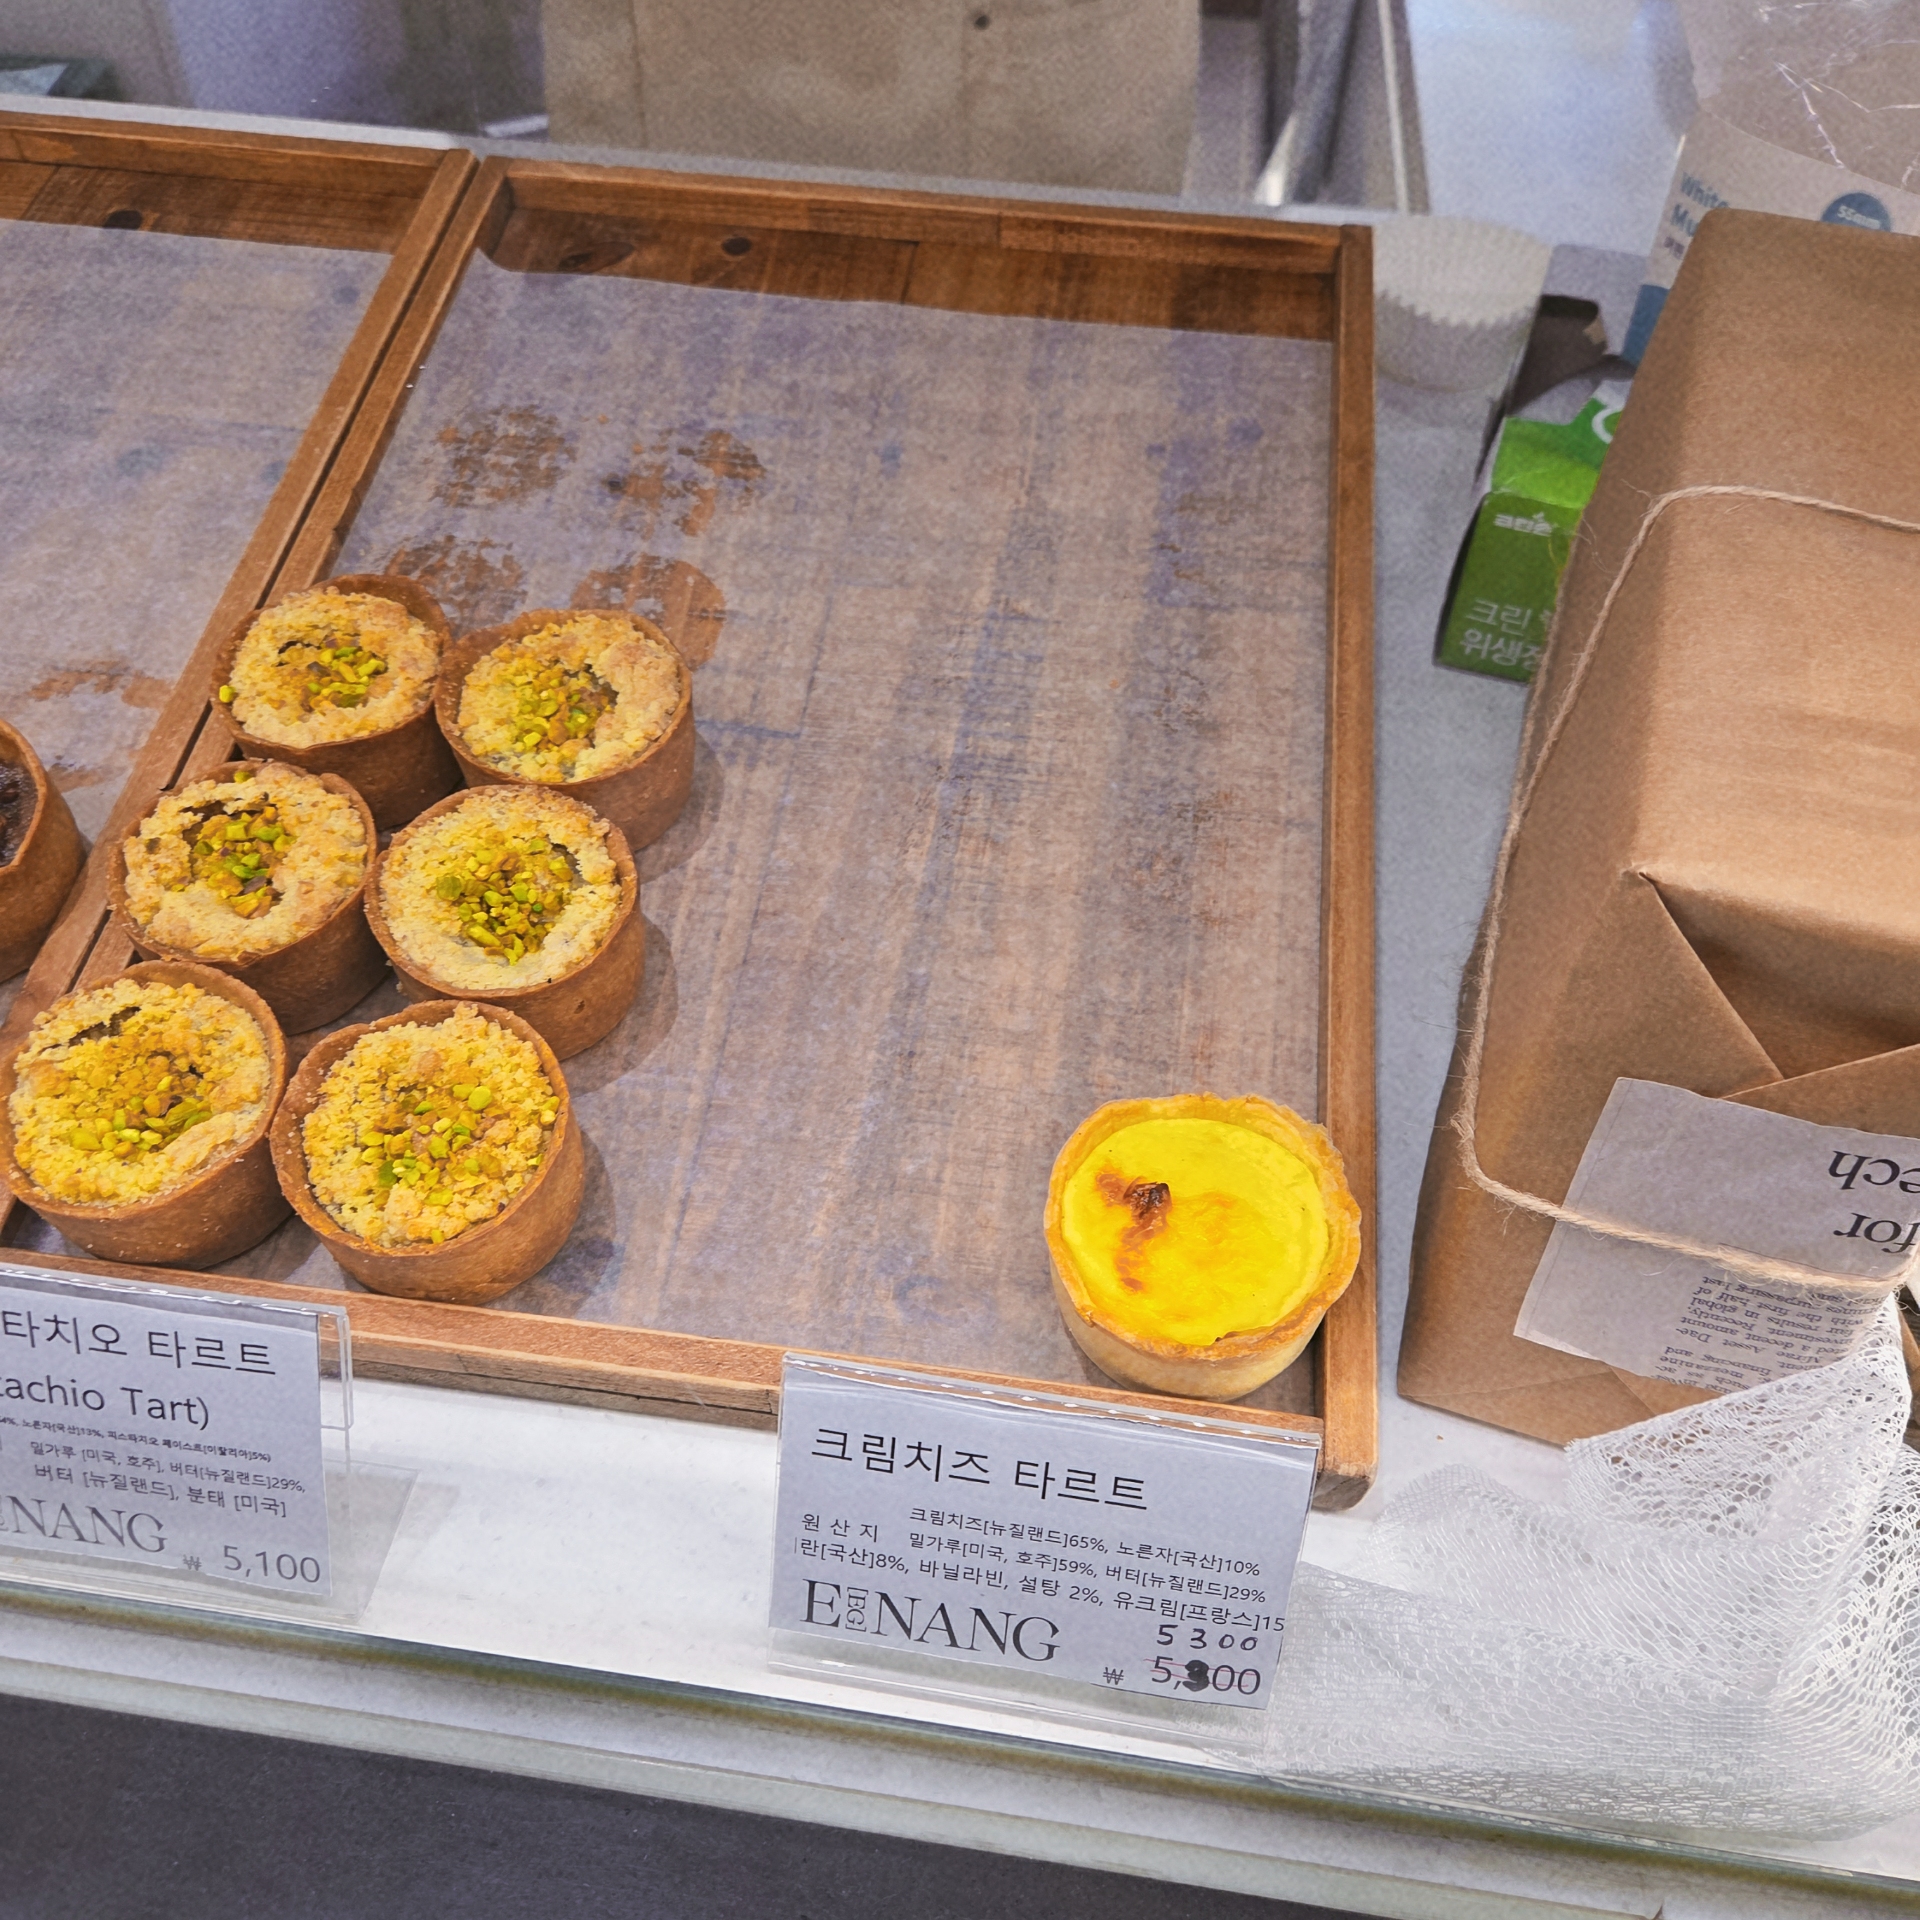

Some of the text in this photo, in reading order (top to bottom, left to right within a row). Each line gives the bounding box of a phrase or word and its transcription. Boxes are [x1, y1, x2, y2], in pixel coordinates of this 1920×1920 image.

[1690, 1297, 1738, 1313] global
[1693, 1287, 1711, 1295] of
[1796, 1312, 1822, 1323] the
[2, 1311, 276, 1375] 타치오 타르트
[1664, 1347, 1693, 1357] and
[120, 1386, 209, 1430] Tart)
[34, 1464, 73, 1484] 버터
[234, 1495, 286, 1517] [미국]
[811, 1428, 1147, 1510] 크림치즈 타르트
[223, 1545, 321, 1583] 5,100
[909, 1507, 1260, 1577] 크림치즈[뉴질랜드]65%, 노른자[국산]10%
[919, 1559, 1009, 1591] 바닐라빈,
[1018, 1575, 1061, 1598] 설탕
[1069, 1585, 1104, 1607] 2%,
[1015, 1551, 1097, 1579] 호주]59%,
[1105, 1565, 1266, 1603] 버터[뉴질랜드]29%
